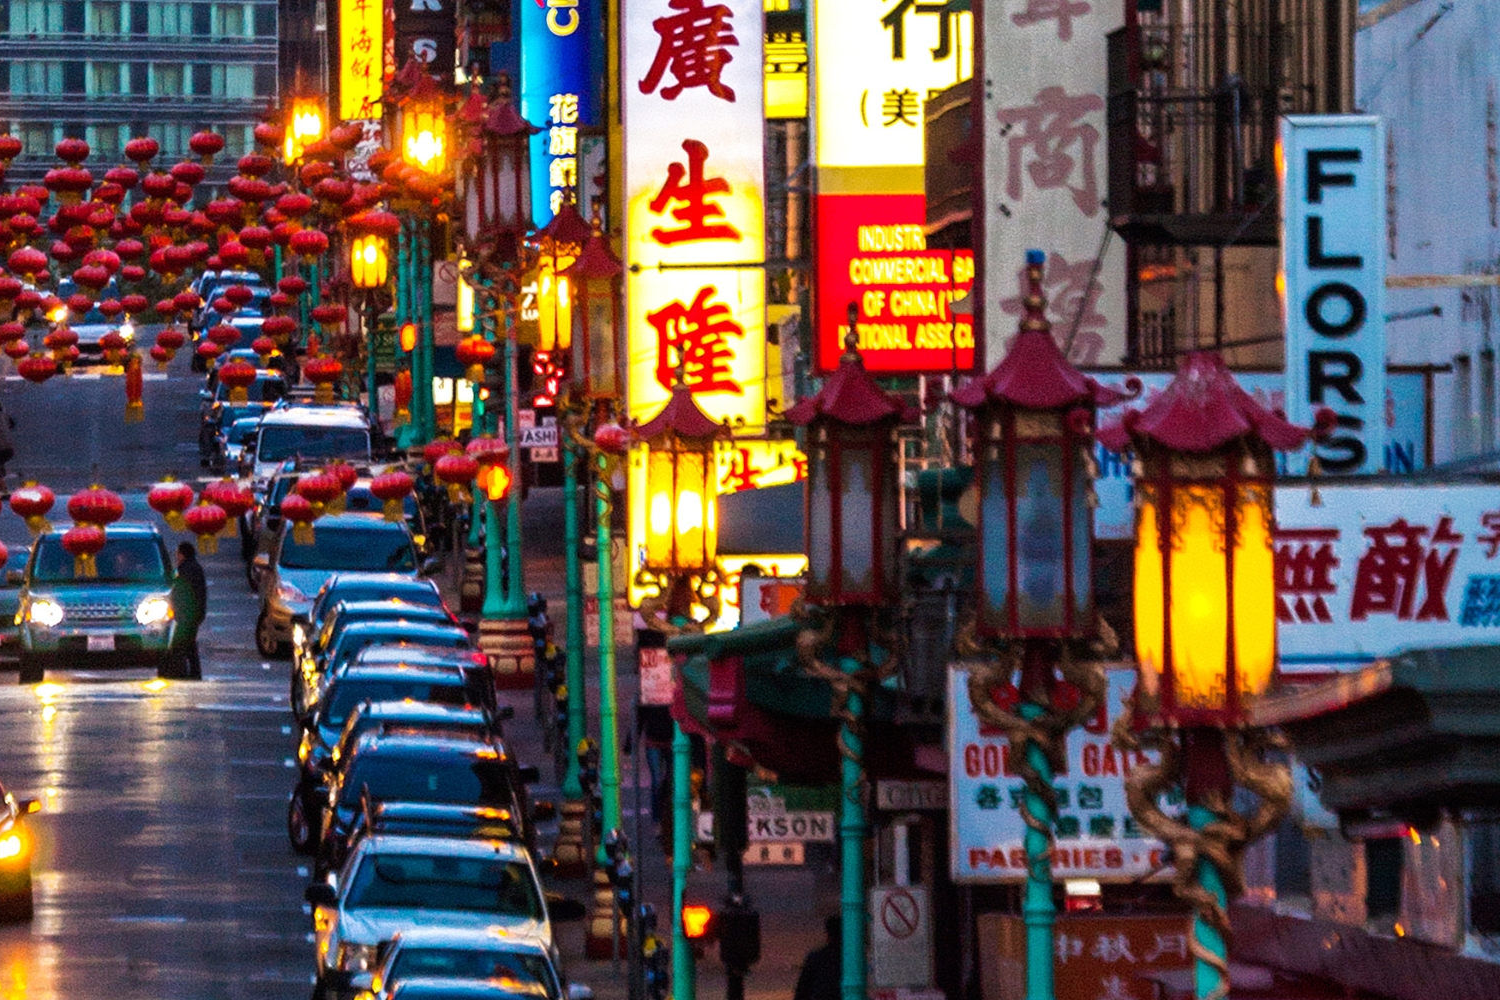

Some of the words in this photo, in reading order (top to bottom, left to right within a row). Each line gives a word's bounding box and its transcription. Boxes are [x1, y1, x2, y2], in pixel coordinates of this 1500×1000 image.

[849, 257, 949, 285] COMMERCIAL
[863, 290, 886, 318] OF
[1305, 148, 1368, 472] FLORS
[838, 323, 912, 350] NTIONAL
[915, 322, 975, 349] ASSOCI
[968, 847, 1124, 870] PASRIES
